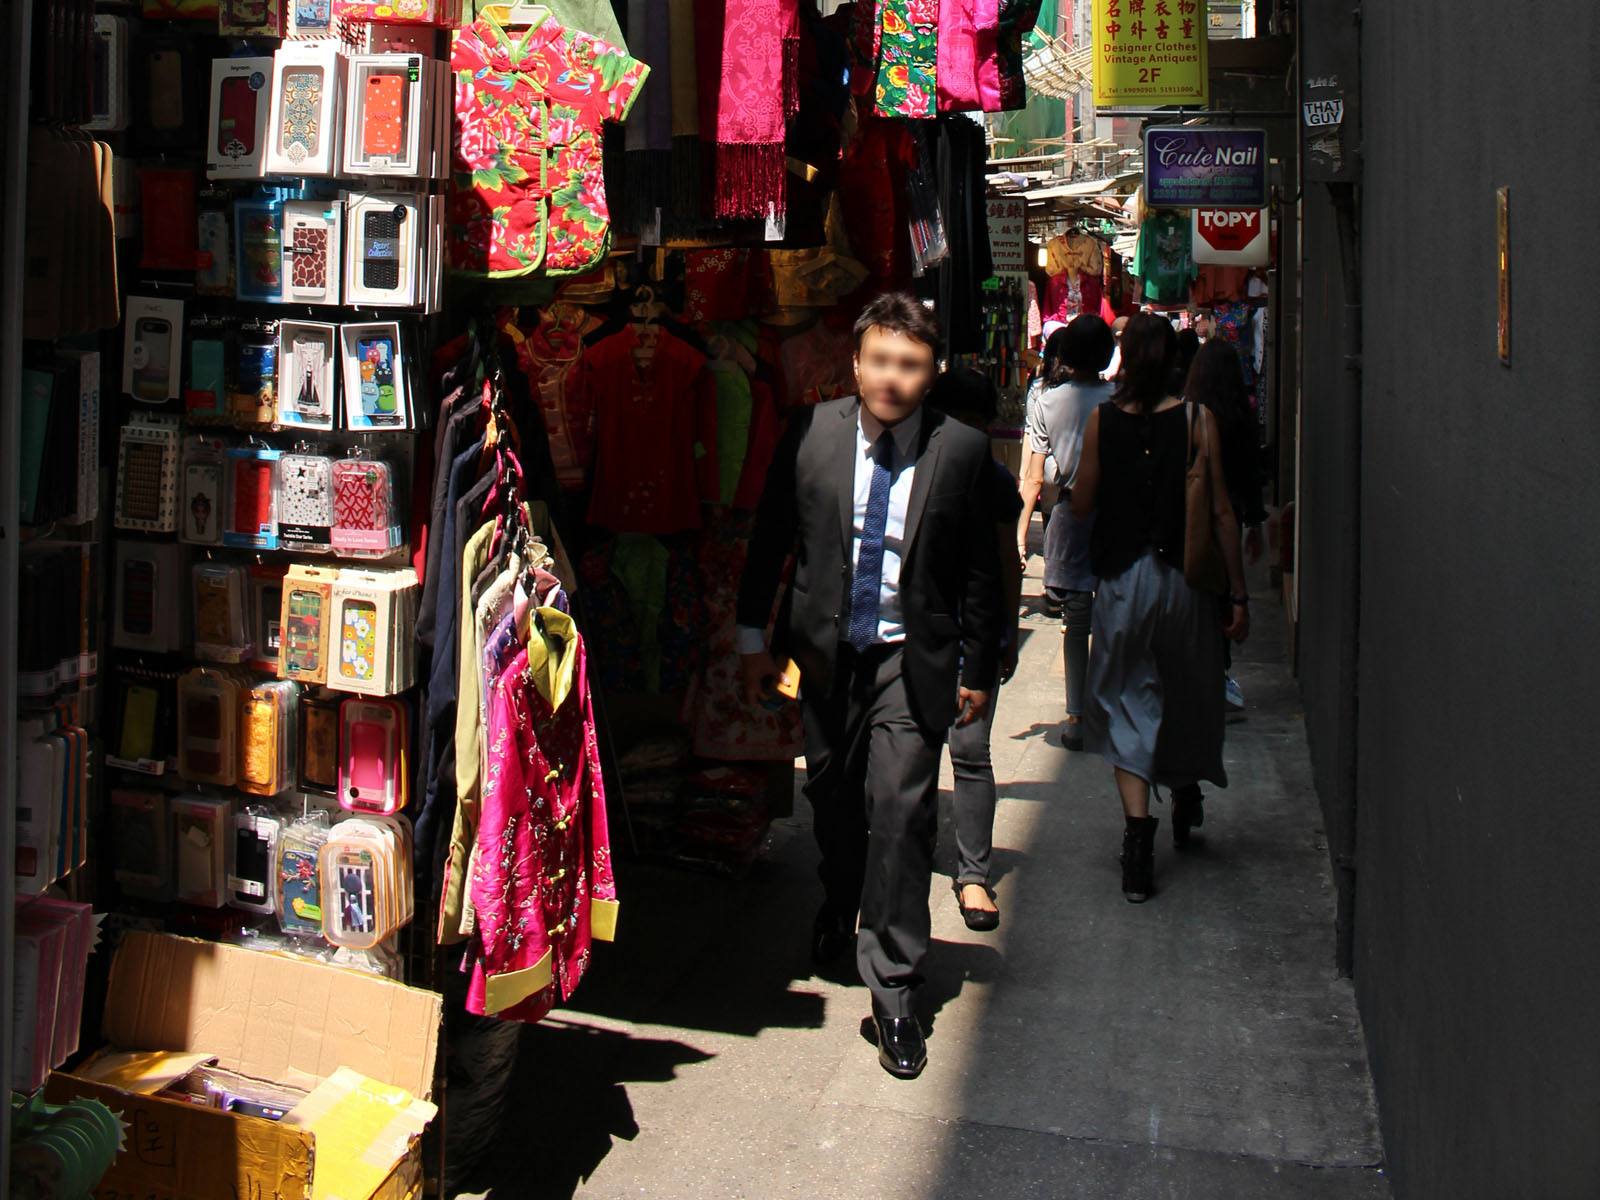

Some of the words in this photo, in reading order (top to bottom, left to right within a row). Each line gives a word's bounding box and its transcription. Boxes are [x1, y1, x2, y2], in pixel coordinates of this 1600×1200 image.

[1105, 18, 1196, 41] 中外古董
[1103, 43, 1153, 55] Designer
[1155, 42, 1198, 52] Clothes
[1104, 54, 1147, 66] Vintage
[1149, 53, 1199, 65] Antiques
[1138, 67, 1162, 84] 2F
[1305, 100, 1342, 114] THAT
[1310, 111, 1339, 125] GUY
[1154, 136, 1213, 169] Cute
[1215, 146, 1258, 166] Nail
[1200, 211, 1258, 227] TOPY
[993, 240, 1020, 248] WATCH
[992, 251, 1021, 259] STRAPS
